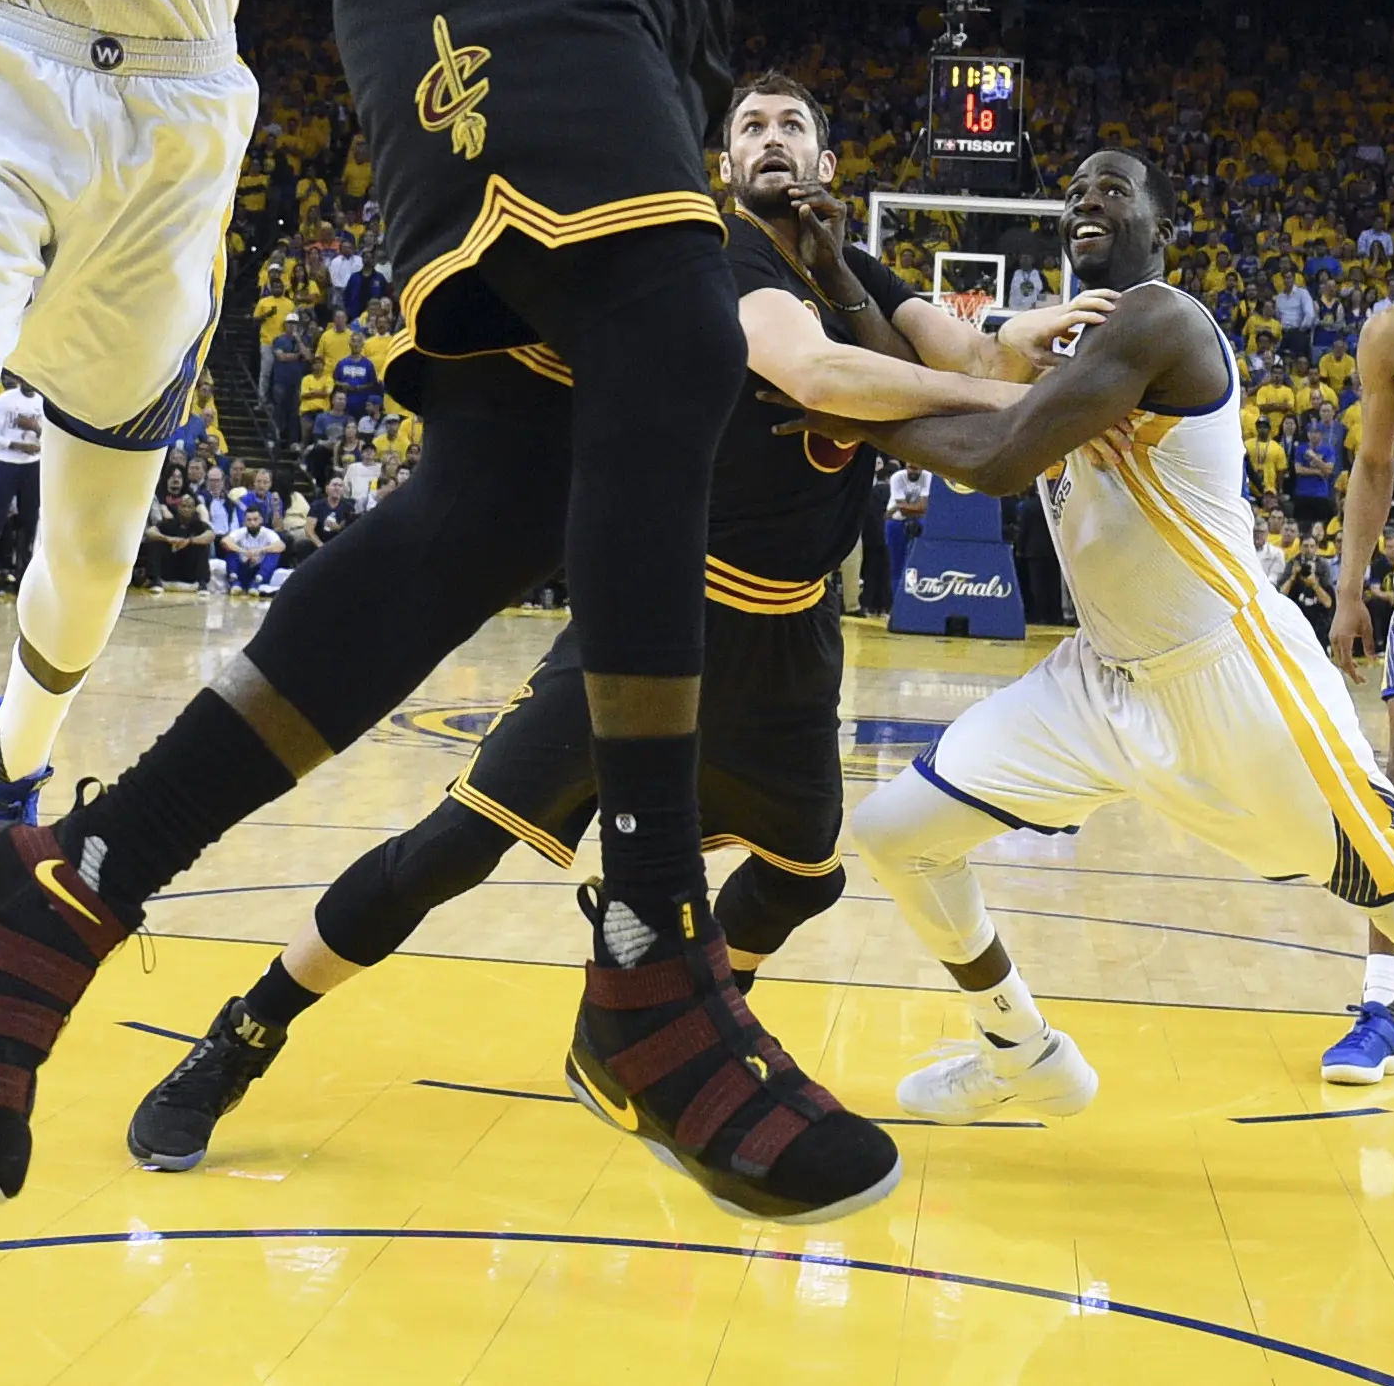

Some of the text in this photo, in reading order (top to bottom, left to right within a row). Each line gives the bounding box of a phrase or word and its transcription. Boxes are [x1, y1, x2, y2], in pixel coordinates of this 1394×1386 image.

[95, 44, 119, 65] W
[952, 65, 1012, 90] 11:37
[957, 139, 1016, 153] TISSOT
[917, 570, 1012, 600] The Finals
